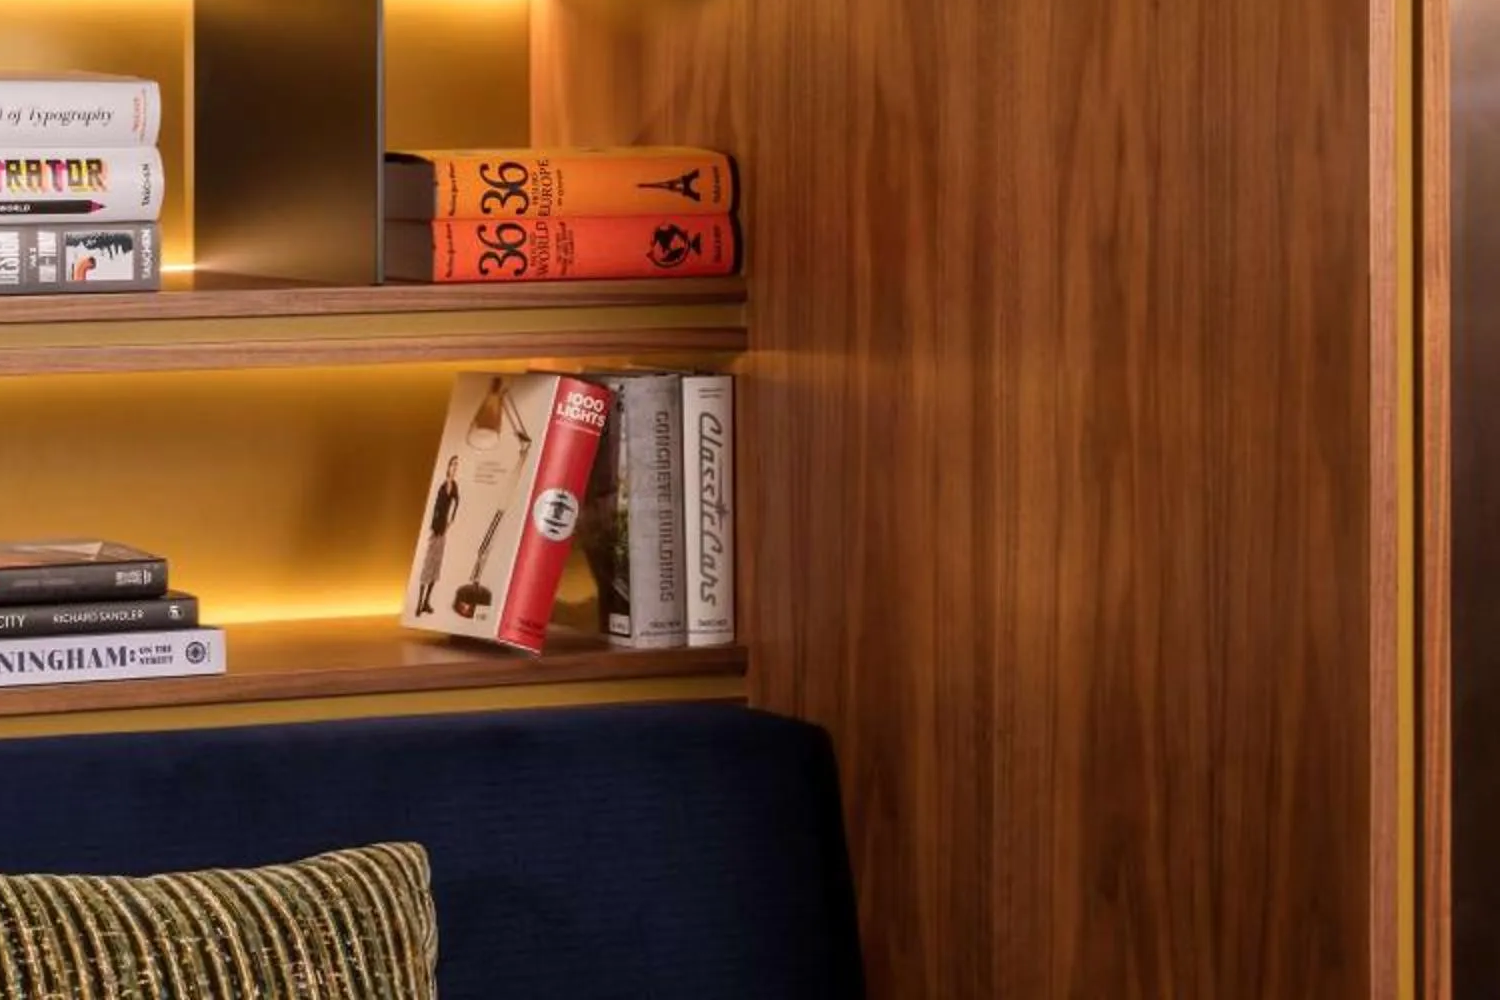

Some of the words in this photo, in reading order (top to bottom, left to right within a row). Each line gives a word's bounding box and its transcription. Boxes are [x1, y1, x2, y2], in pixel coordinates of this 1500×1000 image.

[7, 104, 22, 126] of
[27, 104, 115, 127] Typography
[480, 161, 530, 215] 36
[538, 159, 553, 217] EUROPE
[477, 222, 528, 277] 36
[535, 220, 550, 276] WORLD
[556, 402, 607, 427] LIGHTS
[566, 391, 605, 413] 1000
[655, 411, 672, 502] CONCRETE
[699, 412, 723, 526] Classic
[659, 508, 674, 602] BUILDINGS
[700, 530, 723, 607] Cars
[99, 609, 145, 622] SANDLER
